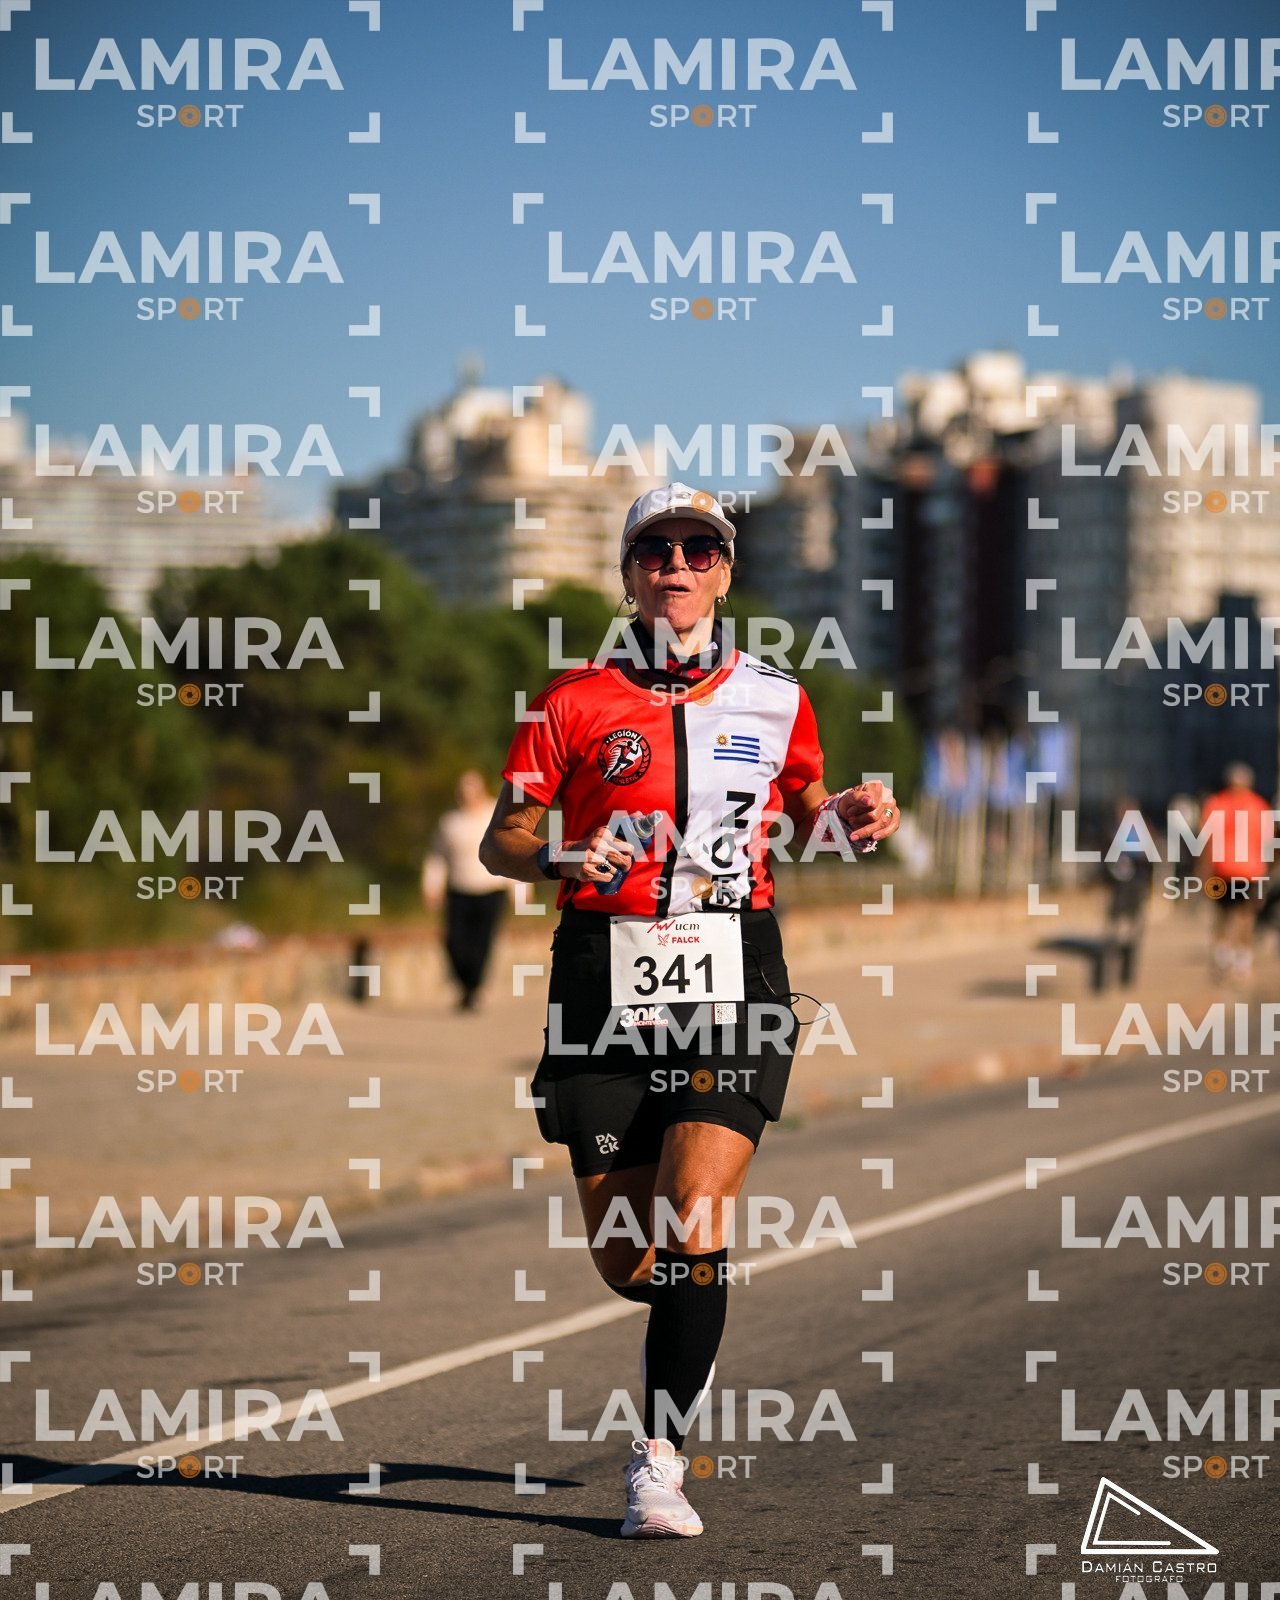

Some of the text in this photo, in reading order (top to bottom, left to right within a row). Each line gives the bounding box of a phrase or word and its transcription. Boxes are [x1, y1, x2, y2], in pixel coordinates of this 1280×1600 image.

[675, 922, 700, 931] ucm
[671, 936, 700, 944] FALCK
[633, 953, 713, 996] 341
[619, 1006, 665, 1028] 30K
